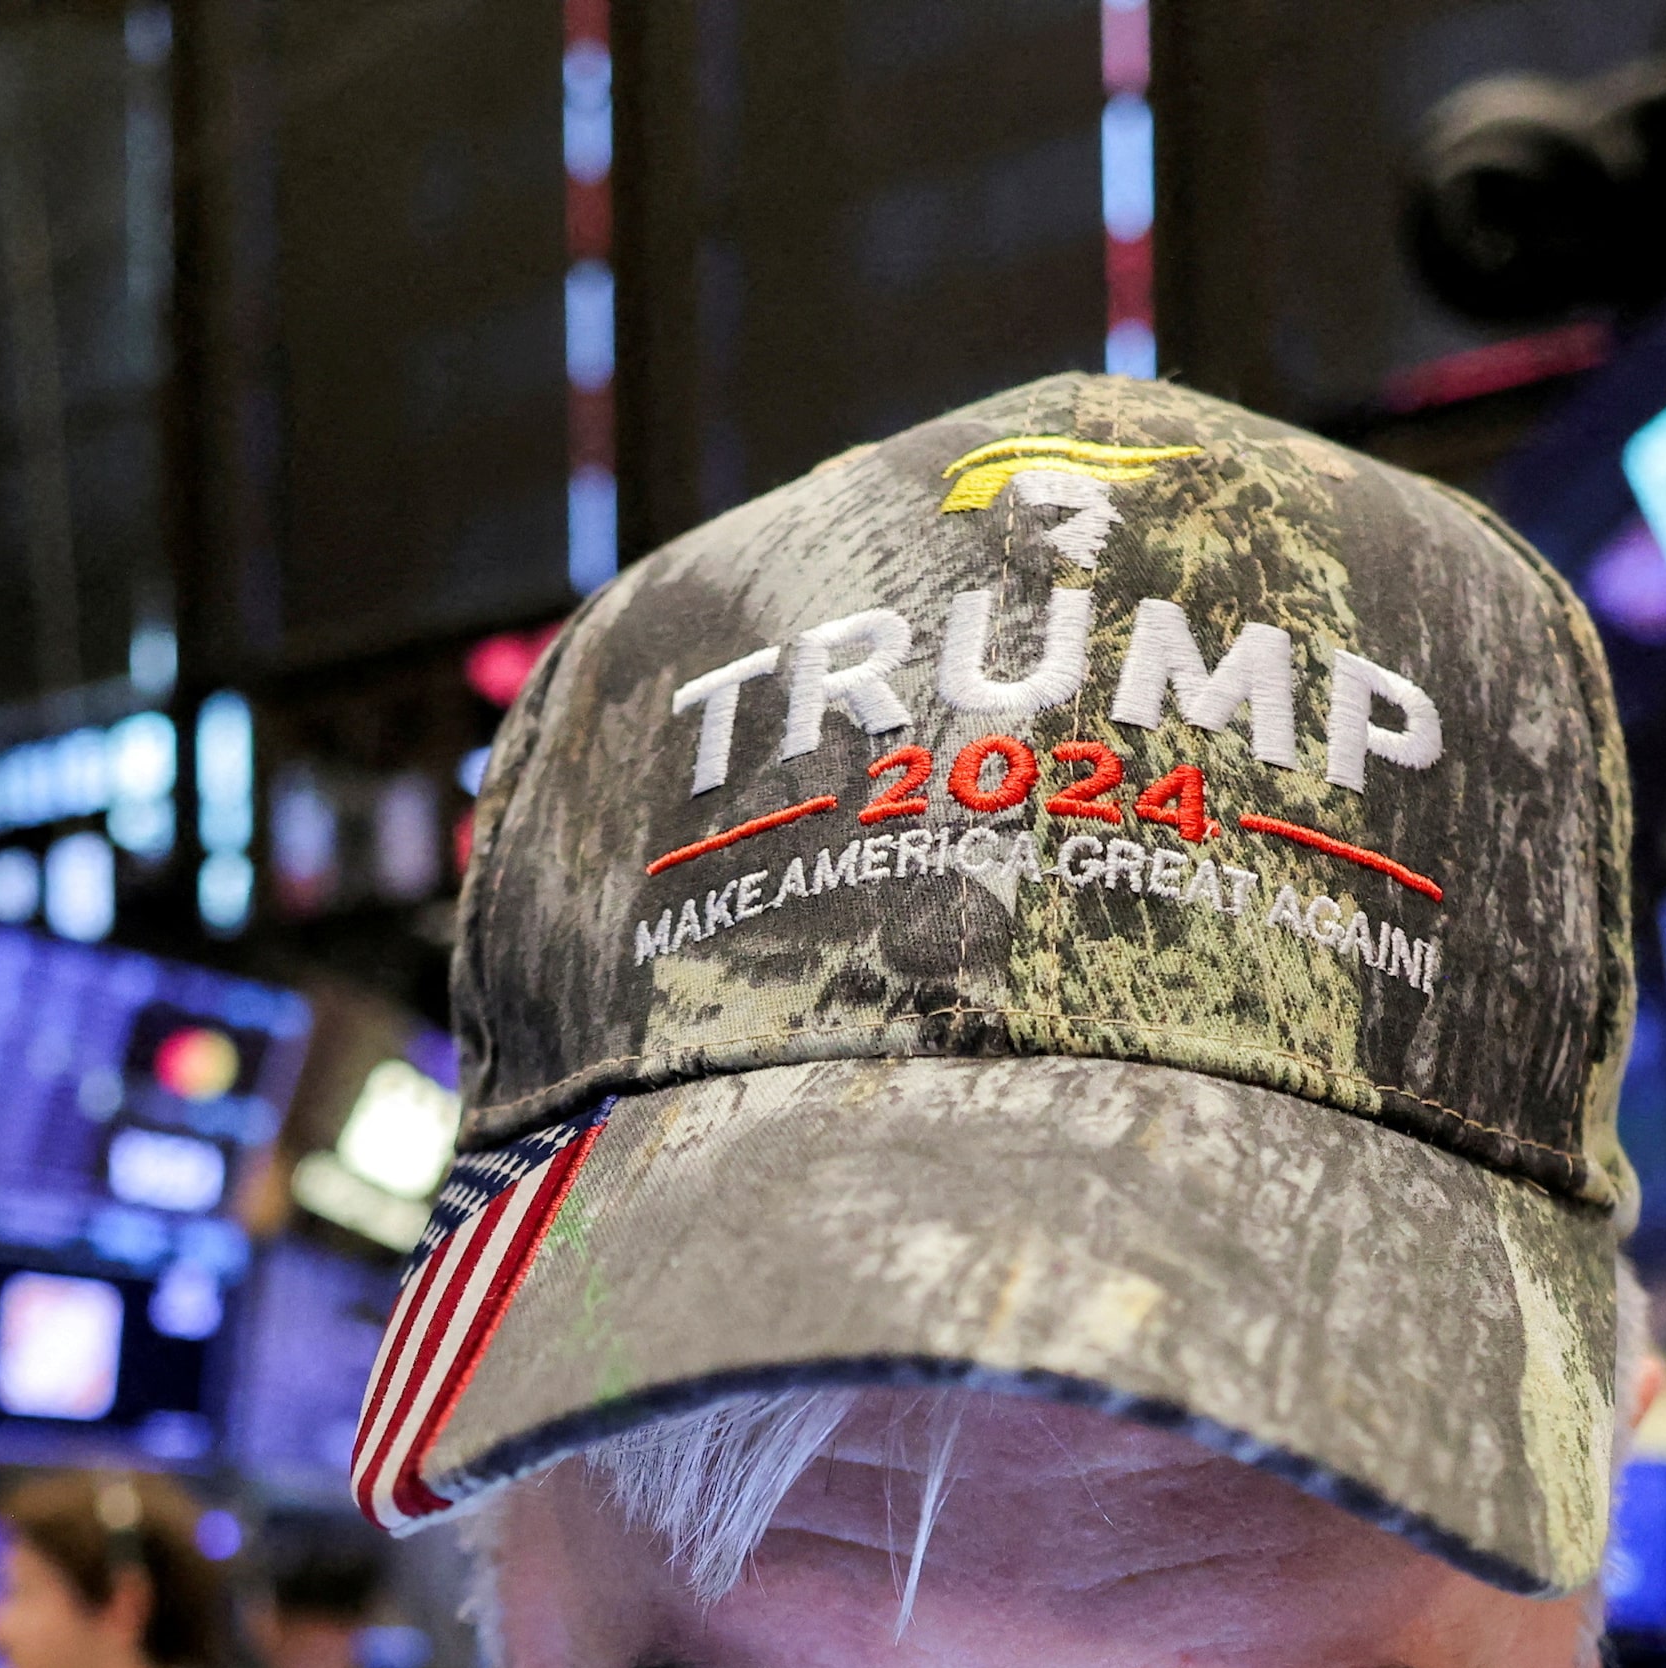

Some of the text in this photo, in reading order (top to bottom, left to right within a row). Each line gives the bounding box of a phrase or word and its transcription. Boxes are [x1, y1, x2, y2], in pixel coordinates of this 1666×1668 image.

[673, 587, 1443, 797] TRUMP
[858, 733, 1221, 843] 2024
[633, 870, 769, 967] MAKE
[774, 825, 1041, 902] AMERICA
[1056, 835, 1259, 916] GREAT
